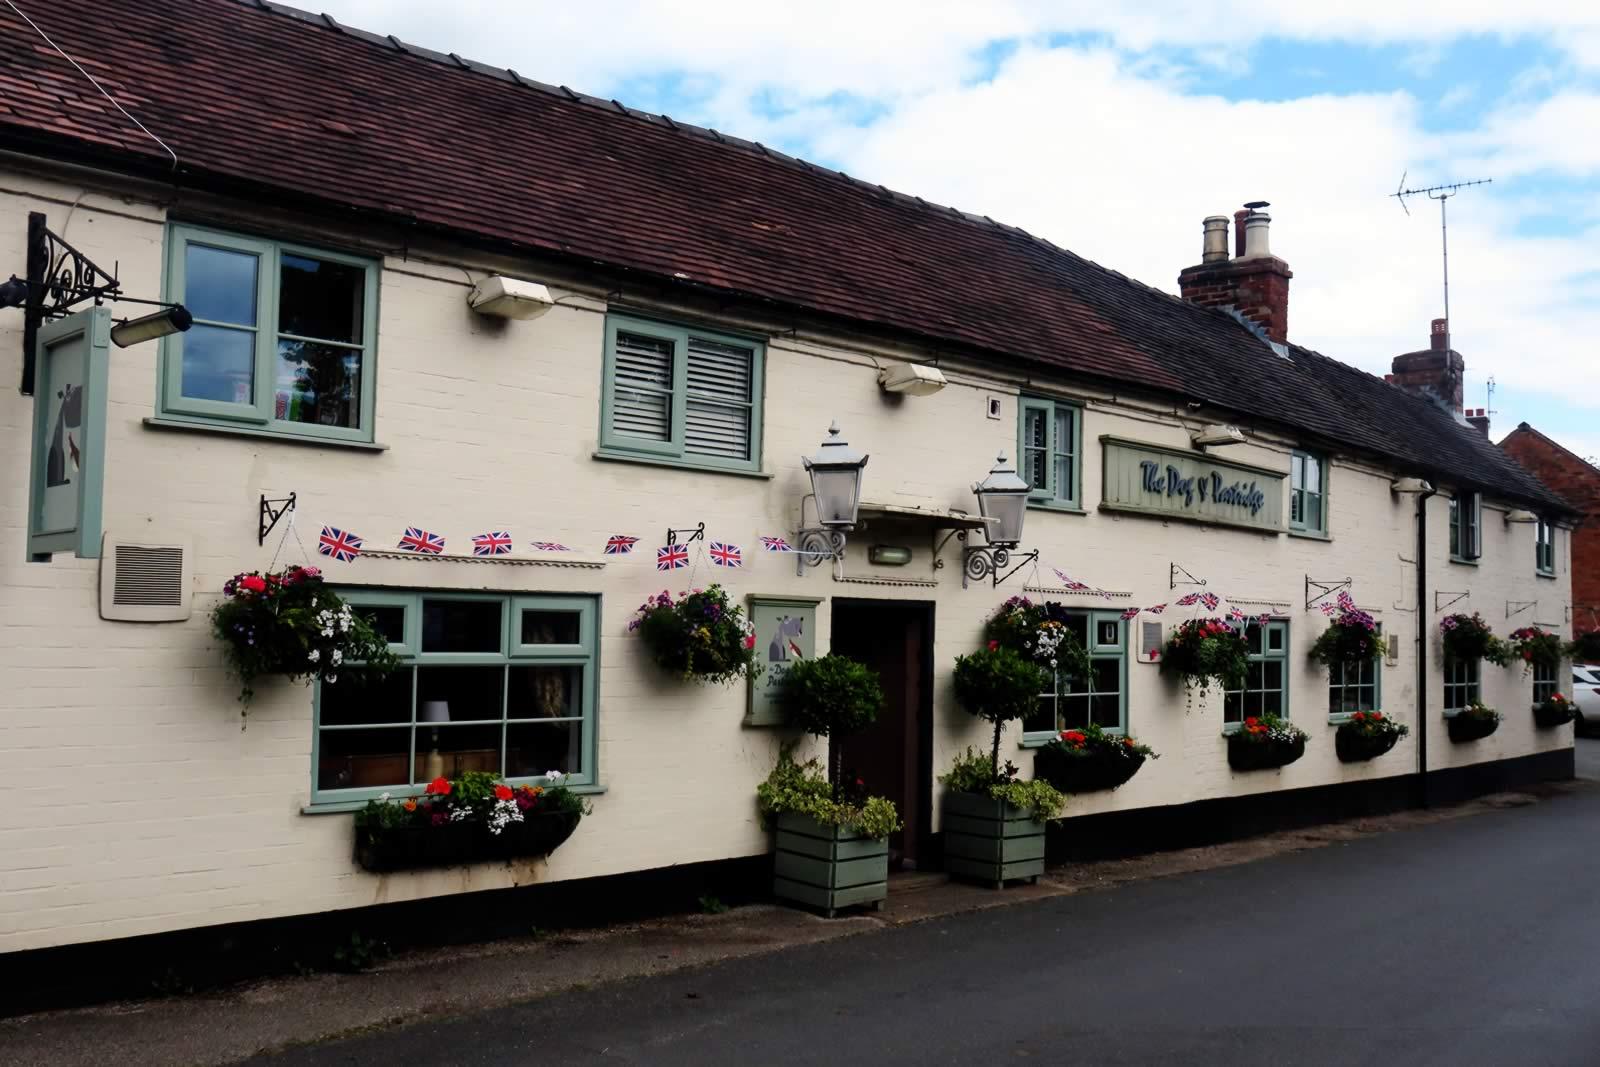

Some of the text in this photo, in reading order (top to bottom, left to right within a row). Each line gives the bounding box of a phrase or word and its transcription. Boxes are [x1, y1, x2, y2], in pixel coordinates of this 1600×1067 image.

[1140, 460, 1166, 495] The
[1166, 465, 1194, 507] Dog
[1211, 471, 1264, 517] Partridge
